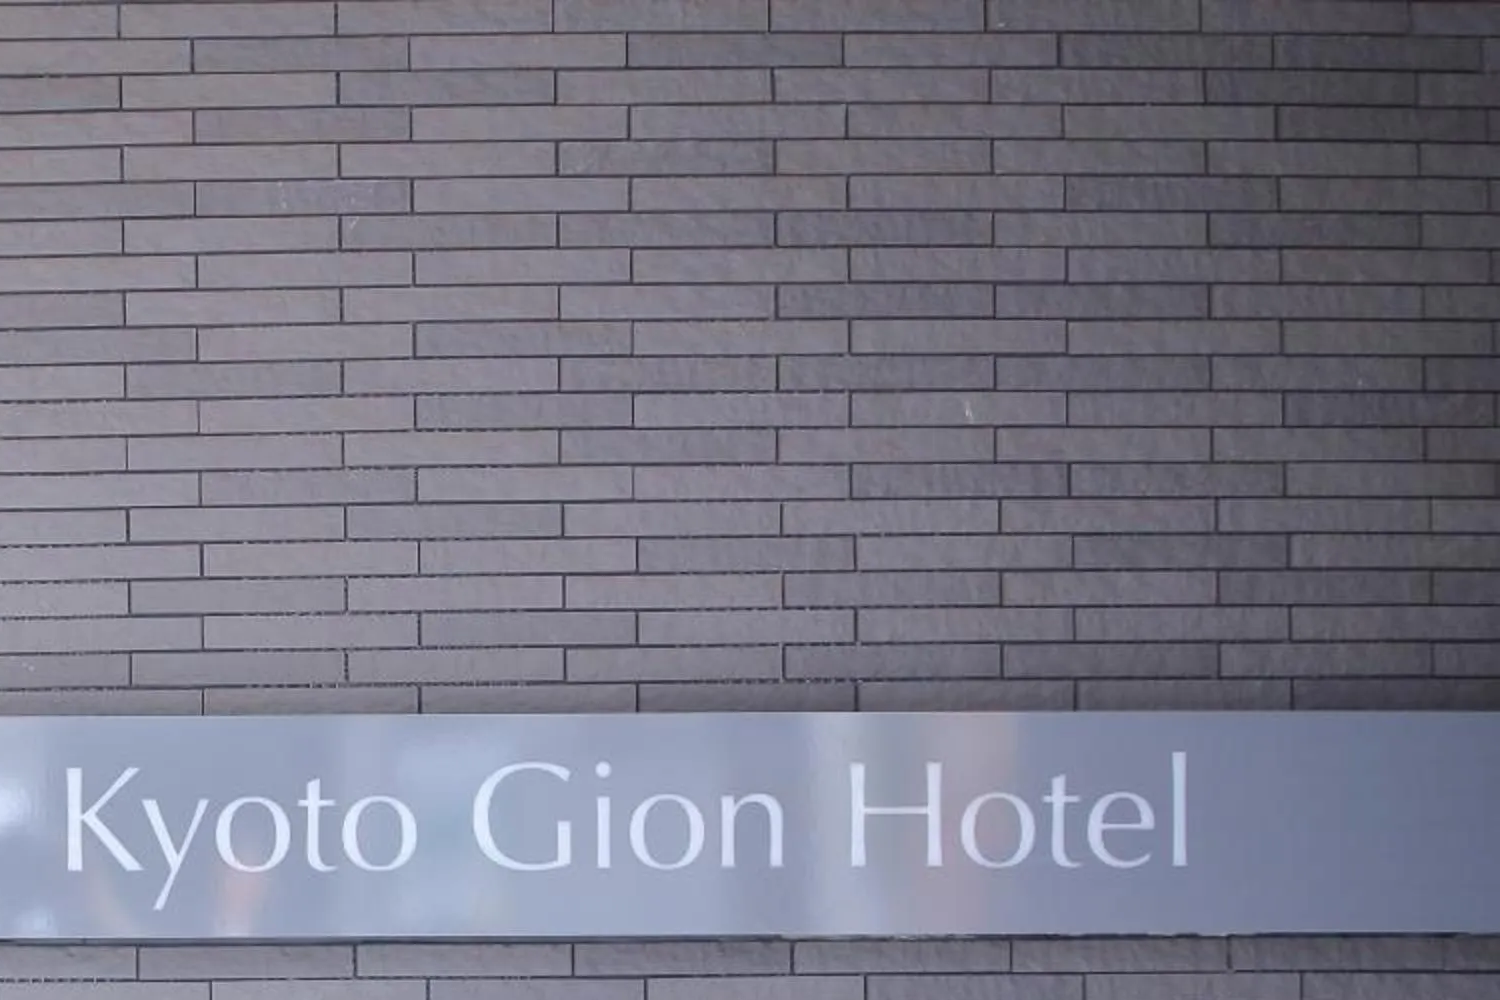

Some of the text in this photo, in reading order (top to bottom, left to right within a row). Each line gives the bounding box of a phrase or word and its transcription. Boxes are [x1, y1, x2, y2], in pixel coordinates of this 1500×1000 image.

[65, 751, 1189, 910] Kyoto Gion Hotel
